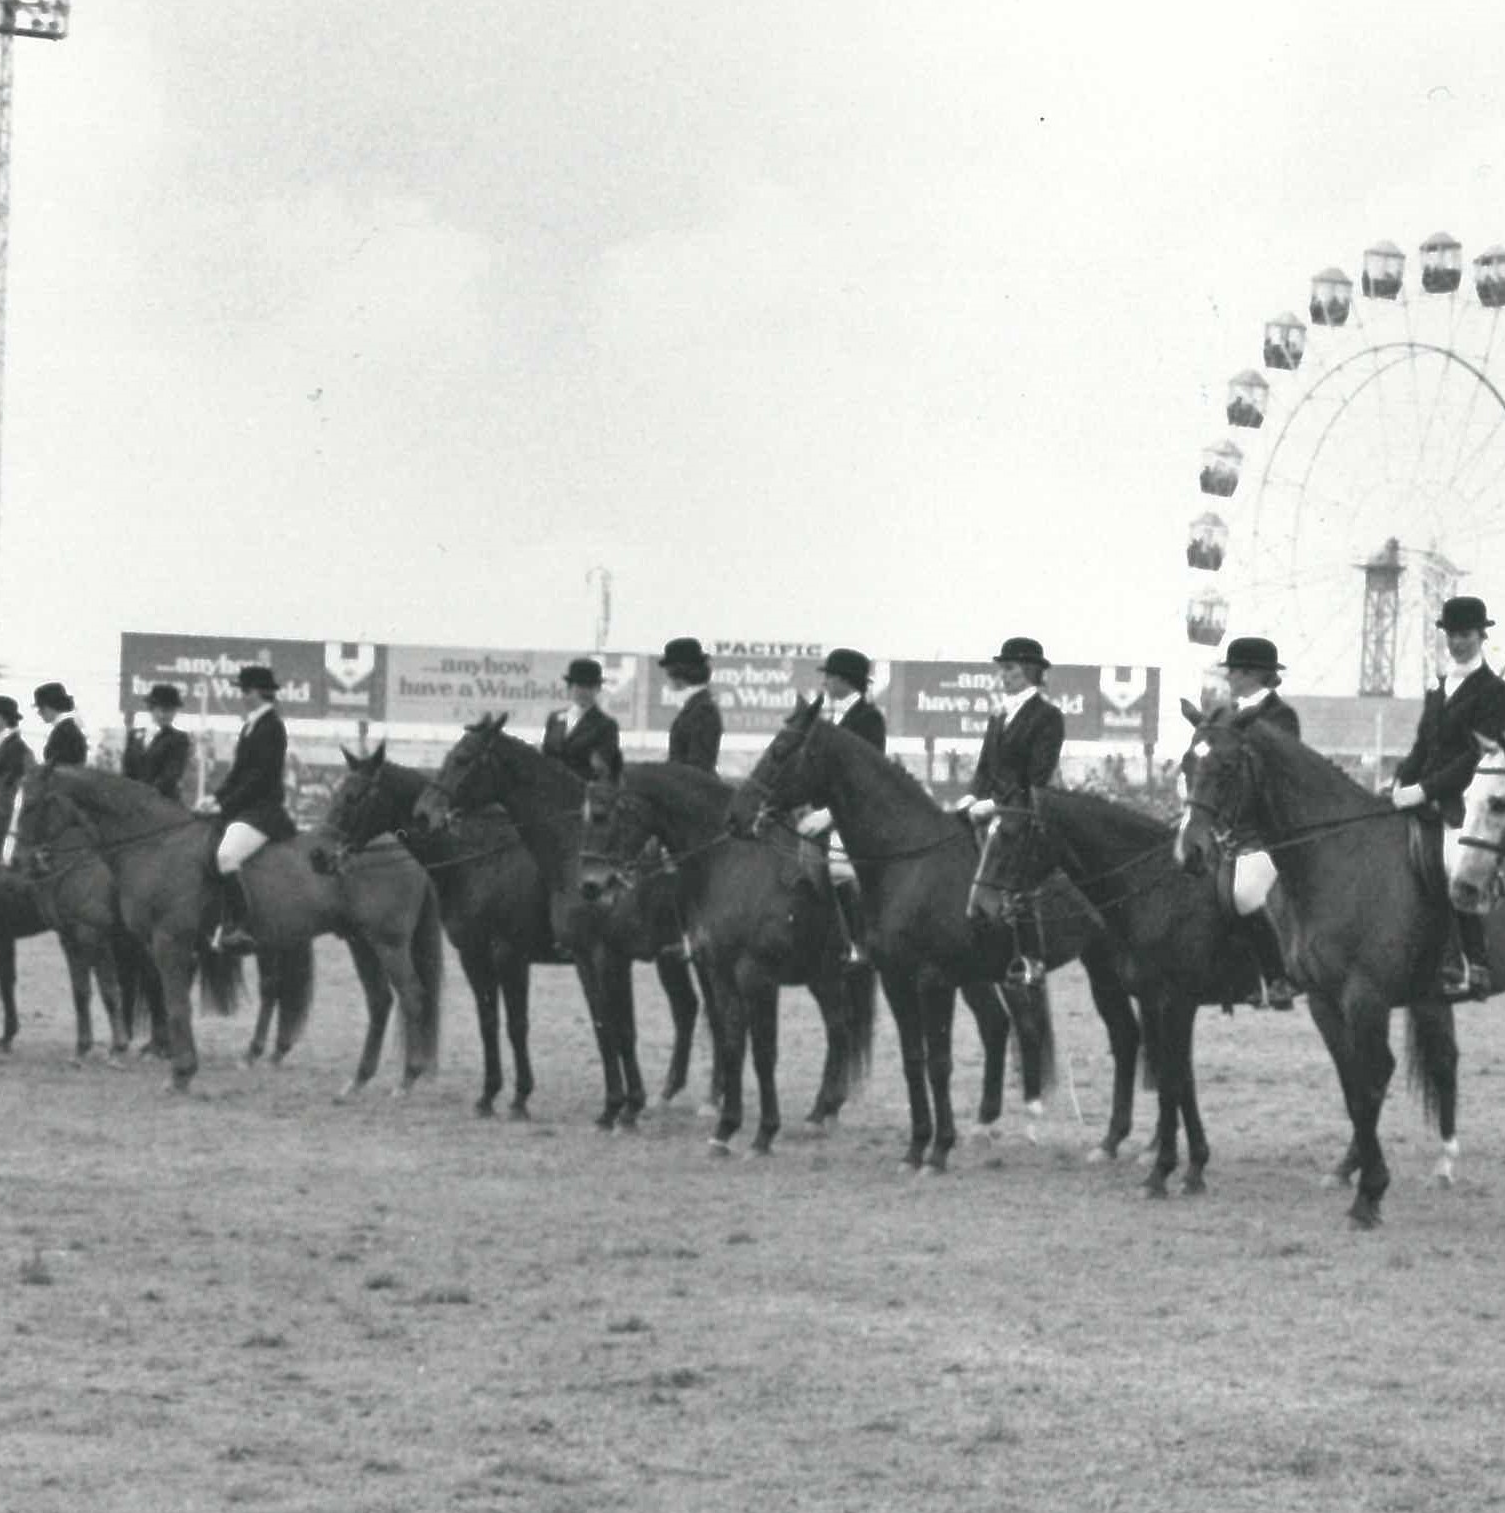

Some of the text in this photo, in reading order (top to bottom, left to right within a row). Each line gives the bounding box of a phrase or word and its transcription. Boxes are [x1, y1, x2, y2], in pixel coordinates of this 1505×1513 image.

[714, 642, 823, 657] PACIFIC
[399, 676, 453, 697] have
[917, 690, 971, 712] have
